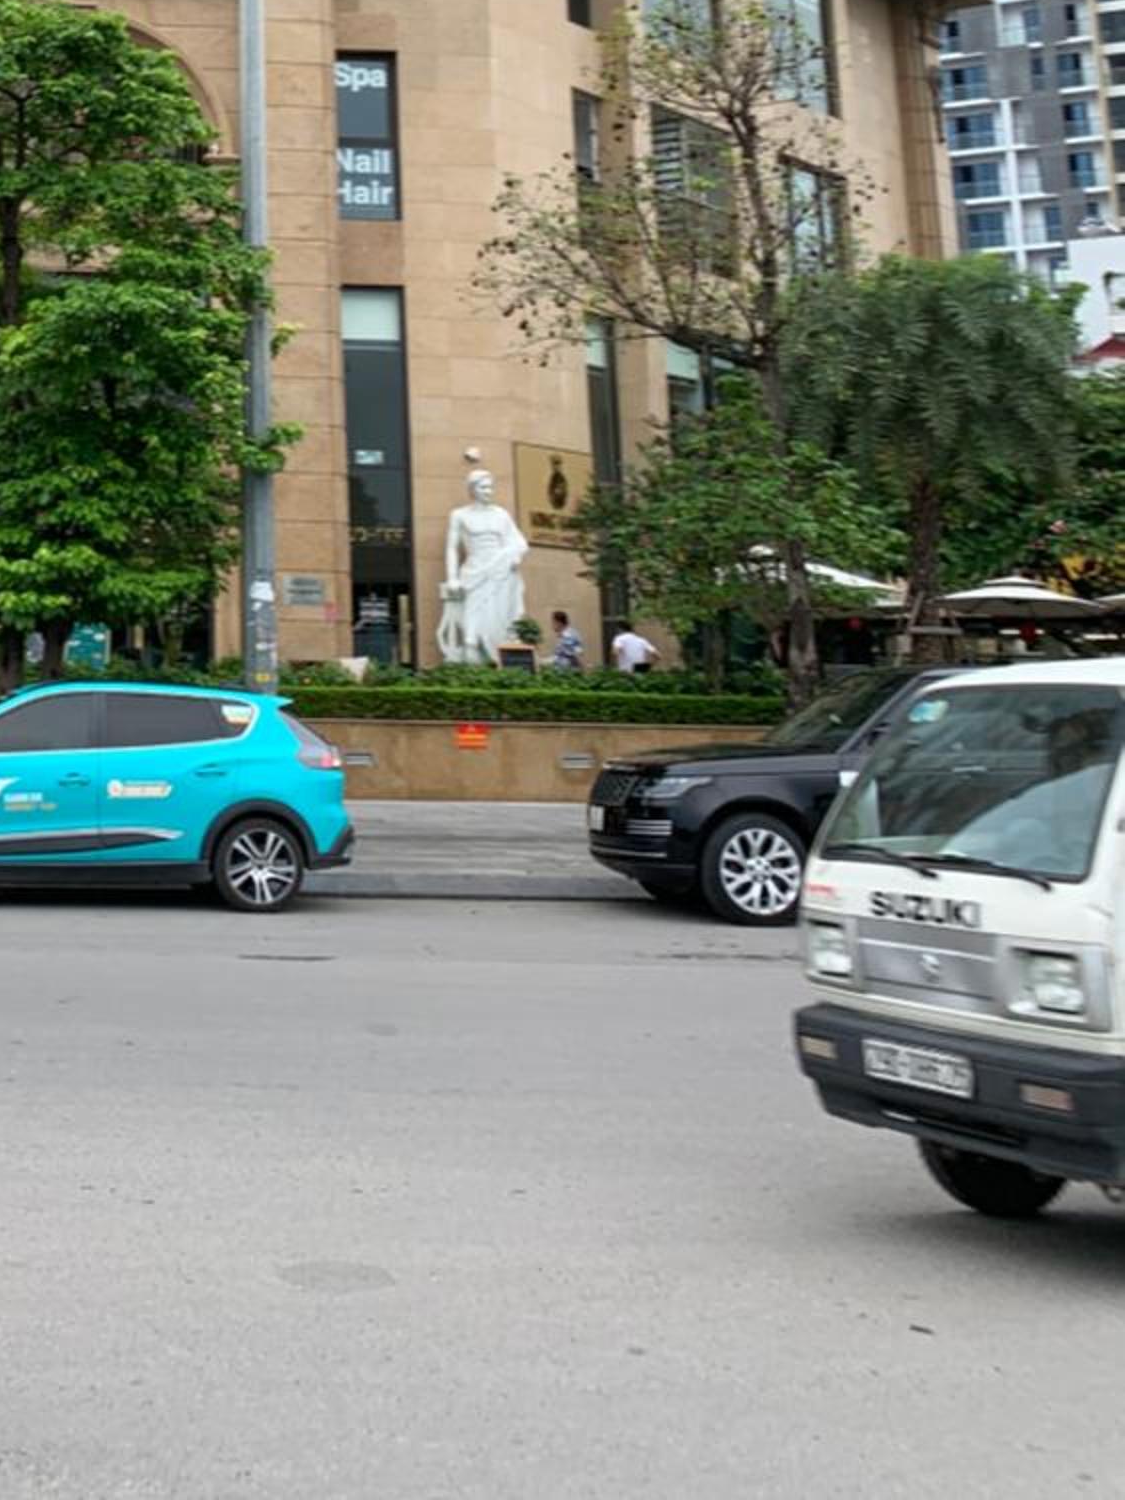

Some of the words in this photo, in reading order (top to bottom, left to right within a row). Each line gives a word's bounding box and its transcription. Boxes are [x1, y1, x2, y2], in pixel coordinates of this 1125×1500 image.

[334, 62, 388, 92] Spa
[336, 147, 392, 174] Nail
[869, 891, 982, 929] SUZUKI
